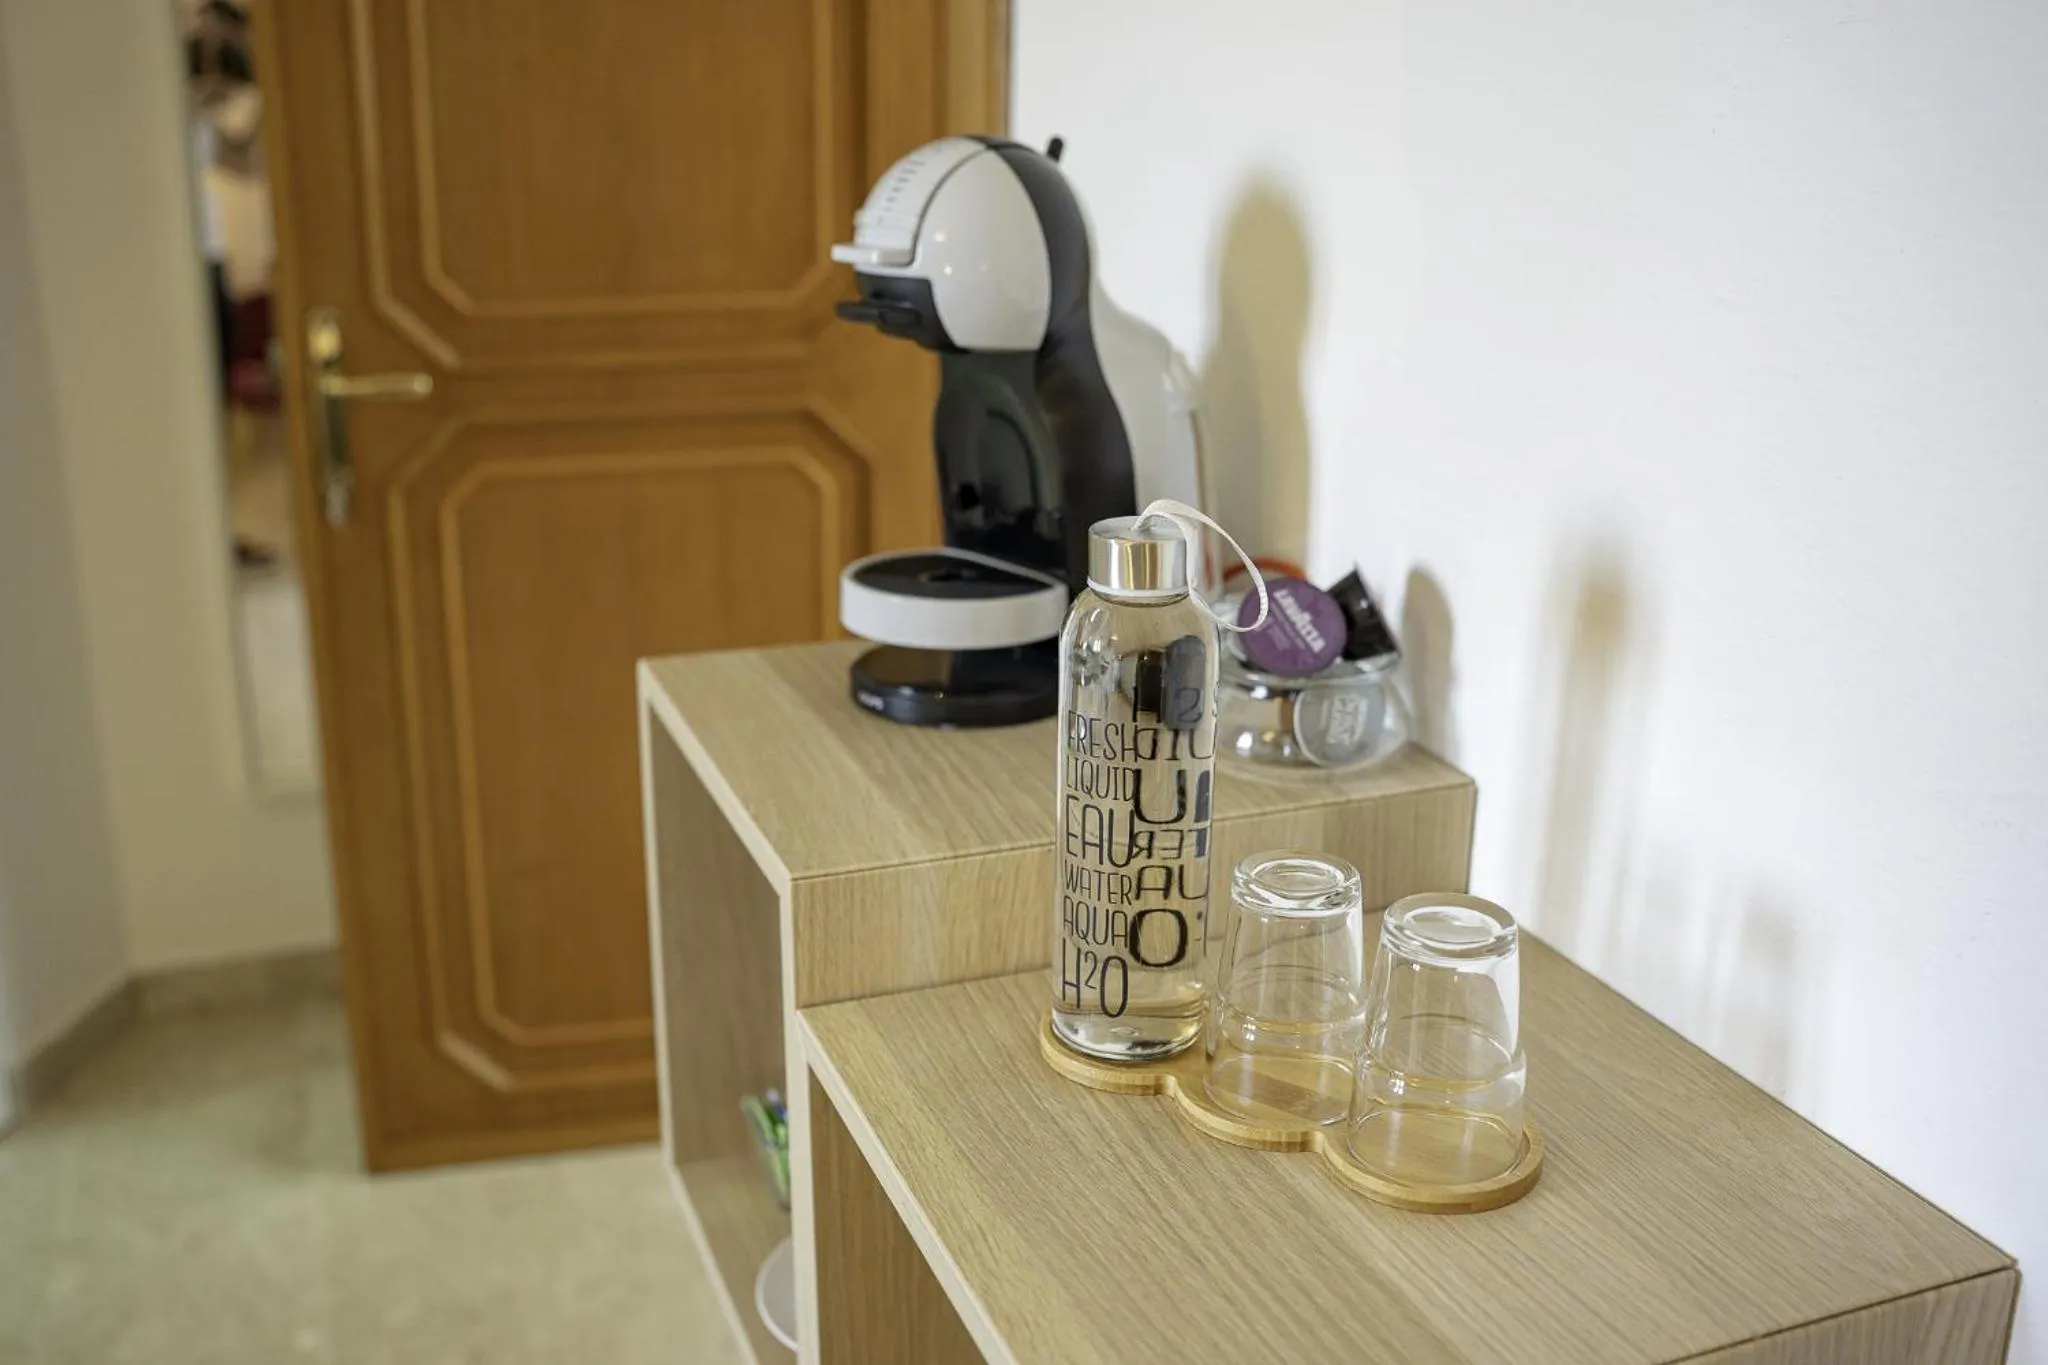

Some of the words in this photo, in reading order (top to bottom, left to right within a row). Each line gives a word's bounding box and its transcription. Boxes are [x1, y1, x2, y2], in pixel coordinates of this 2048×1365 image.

[1066, 708, 1138, 763] FRESH
[1065, 756, 1137, 802] LIQUID
[1065, 794, 1136, 869] EAU
[1064, 858, 1134, 907] WATER
[1062, 895, 1130, 949] AQUA
